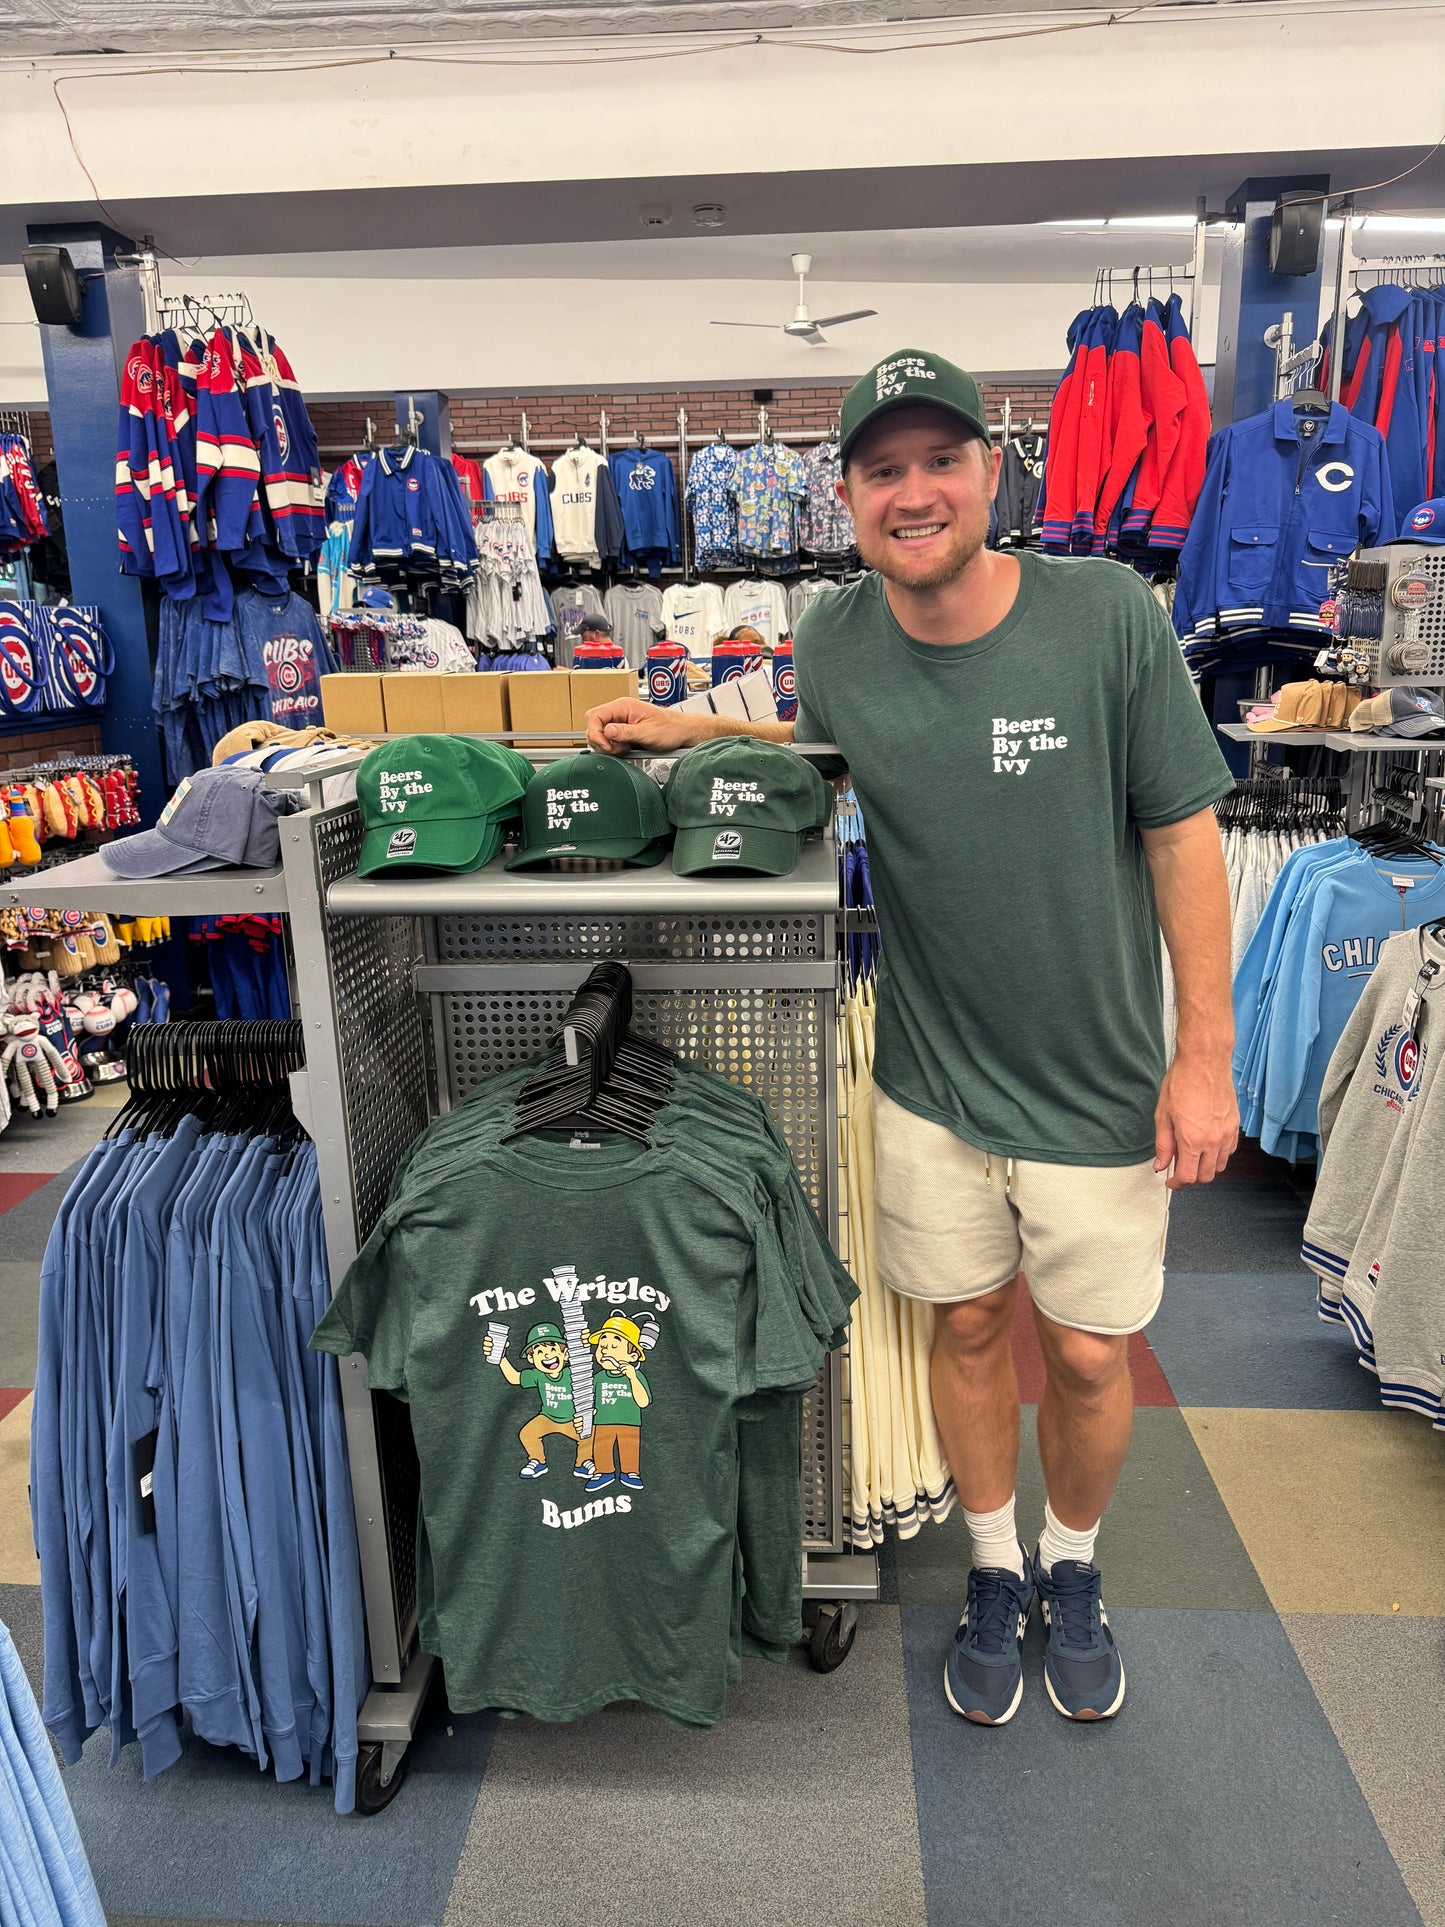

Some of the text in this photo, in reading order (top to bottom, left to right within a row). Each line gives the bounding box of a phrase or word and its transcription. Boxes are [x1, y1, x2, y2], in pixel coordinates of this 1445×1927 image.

[876, 357, 926, 379] Beers
[876, 366, 936, 390] By the
[876, 382, 907, 401] Ivy
[1315, 461, 1355, 492] C
[562, 492, 592, 504] CUBS
[674, 625, 695, 635] CUBS
[263, 638, 313, 667] CUBS
[991, 717, 1056, 735] Beers
[992, 733, 1069, 757] By the
[992, 756, 1031, 775] Ivy
[380, 770, 422, 785] Beers
[712, 777, 758, 791] Beers
[380, 782, 433, 800] By the
[546, 788, 590, 802] Beers
[710, 790, 765, 804] By the
[380, 799, 407, 813] Ivy
[547, 800, 599, 817] By the
[709, 802, 737, 817] Ivy
[547, 816, 572, 830] Ivy
[469, 1274, 671, 1317] The Wrigley
[545, 1383, 566, 1393] Beers
[601, 1382, 627, 1390] Beers
[601, 1389, 632, 1398] By the
[546, 1390, 556, 1400] By
[601, 1397, 617, 1405] Ivy
[547, 1398, 558, 1409] Ivy
[541, 1494, 632, 1530] Bums
